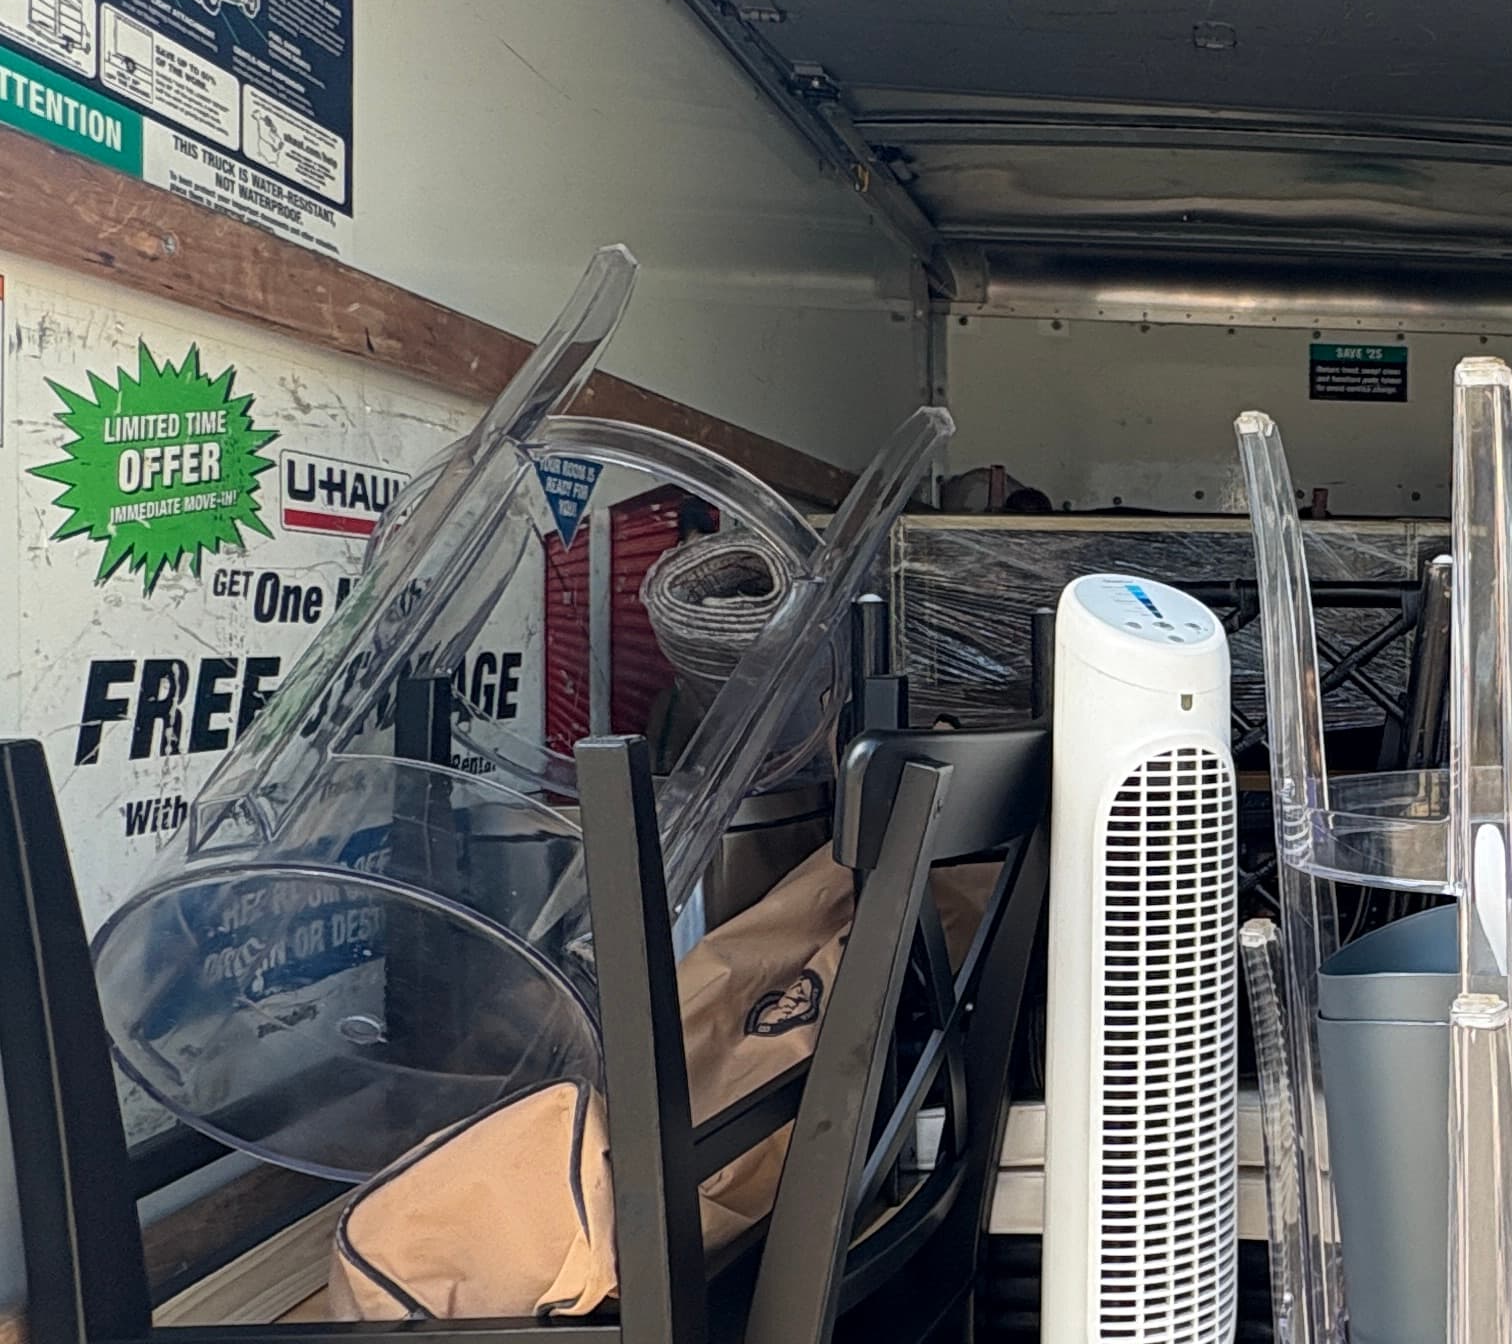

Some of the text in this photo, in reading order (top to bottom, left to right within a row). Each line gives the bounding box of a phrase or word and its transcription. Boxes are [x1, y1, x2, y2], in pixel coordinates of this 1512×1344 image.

[0, 63, 122, 152] TTENTION
[172, 134, 199, 160] THIS
[201, 147, 236, 178] TRUCK
[238, 165, 249, 184] IS
[215, 172, 236, 194] NOT
[238, 182, 304, 226] WATERPROOF.
[104, 410, 227, 443] LIMITED TIME
[118, 442, 222, 493] OFFER
[110, 490, 237, 524] IMMEDIATE MOVE-IN!
[213, 569, 255, 597] GET
[254, 571, 324, 624] One
[124, 795, 189, 837] With
